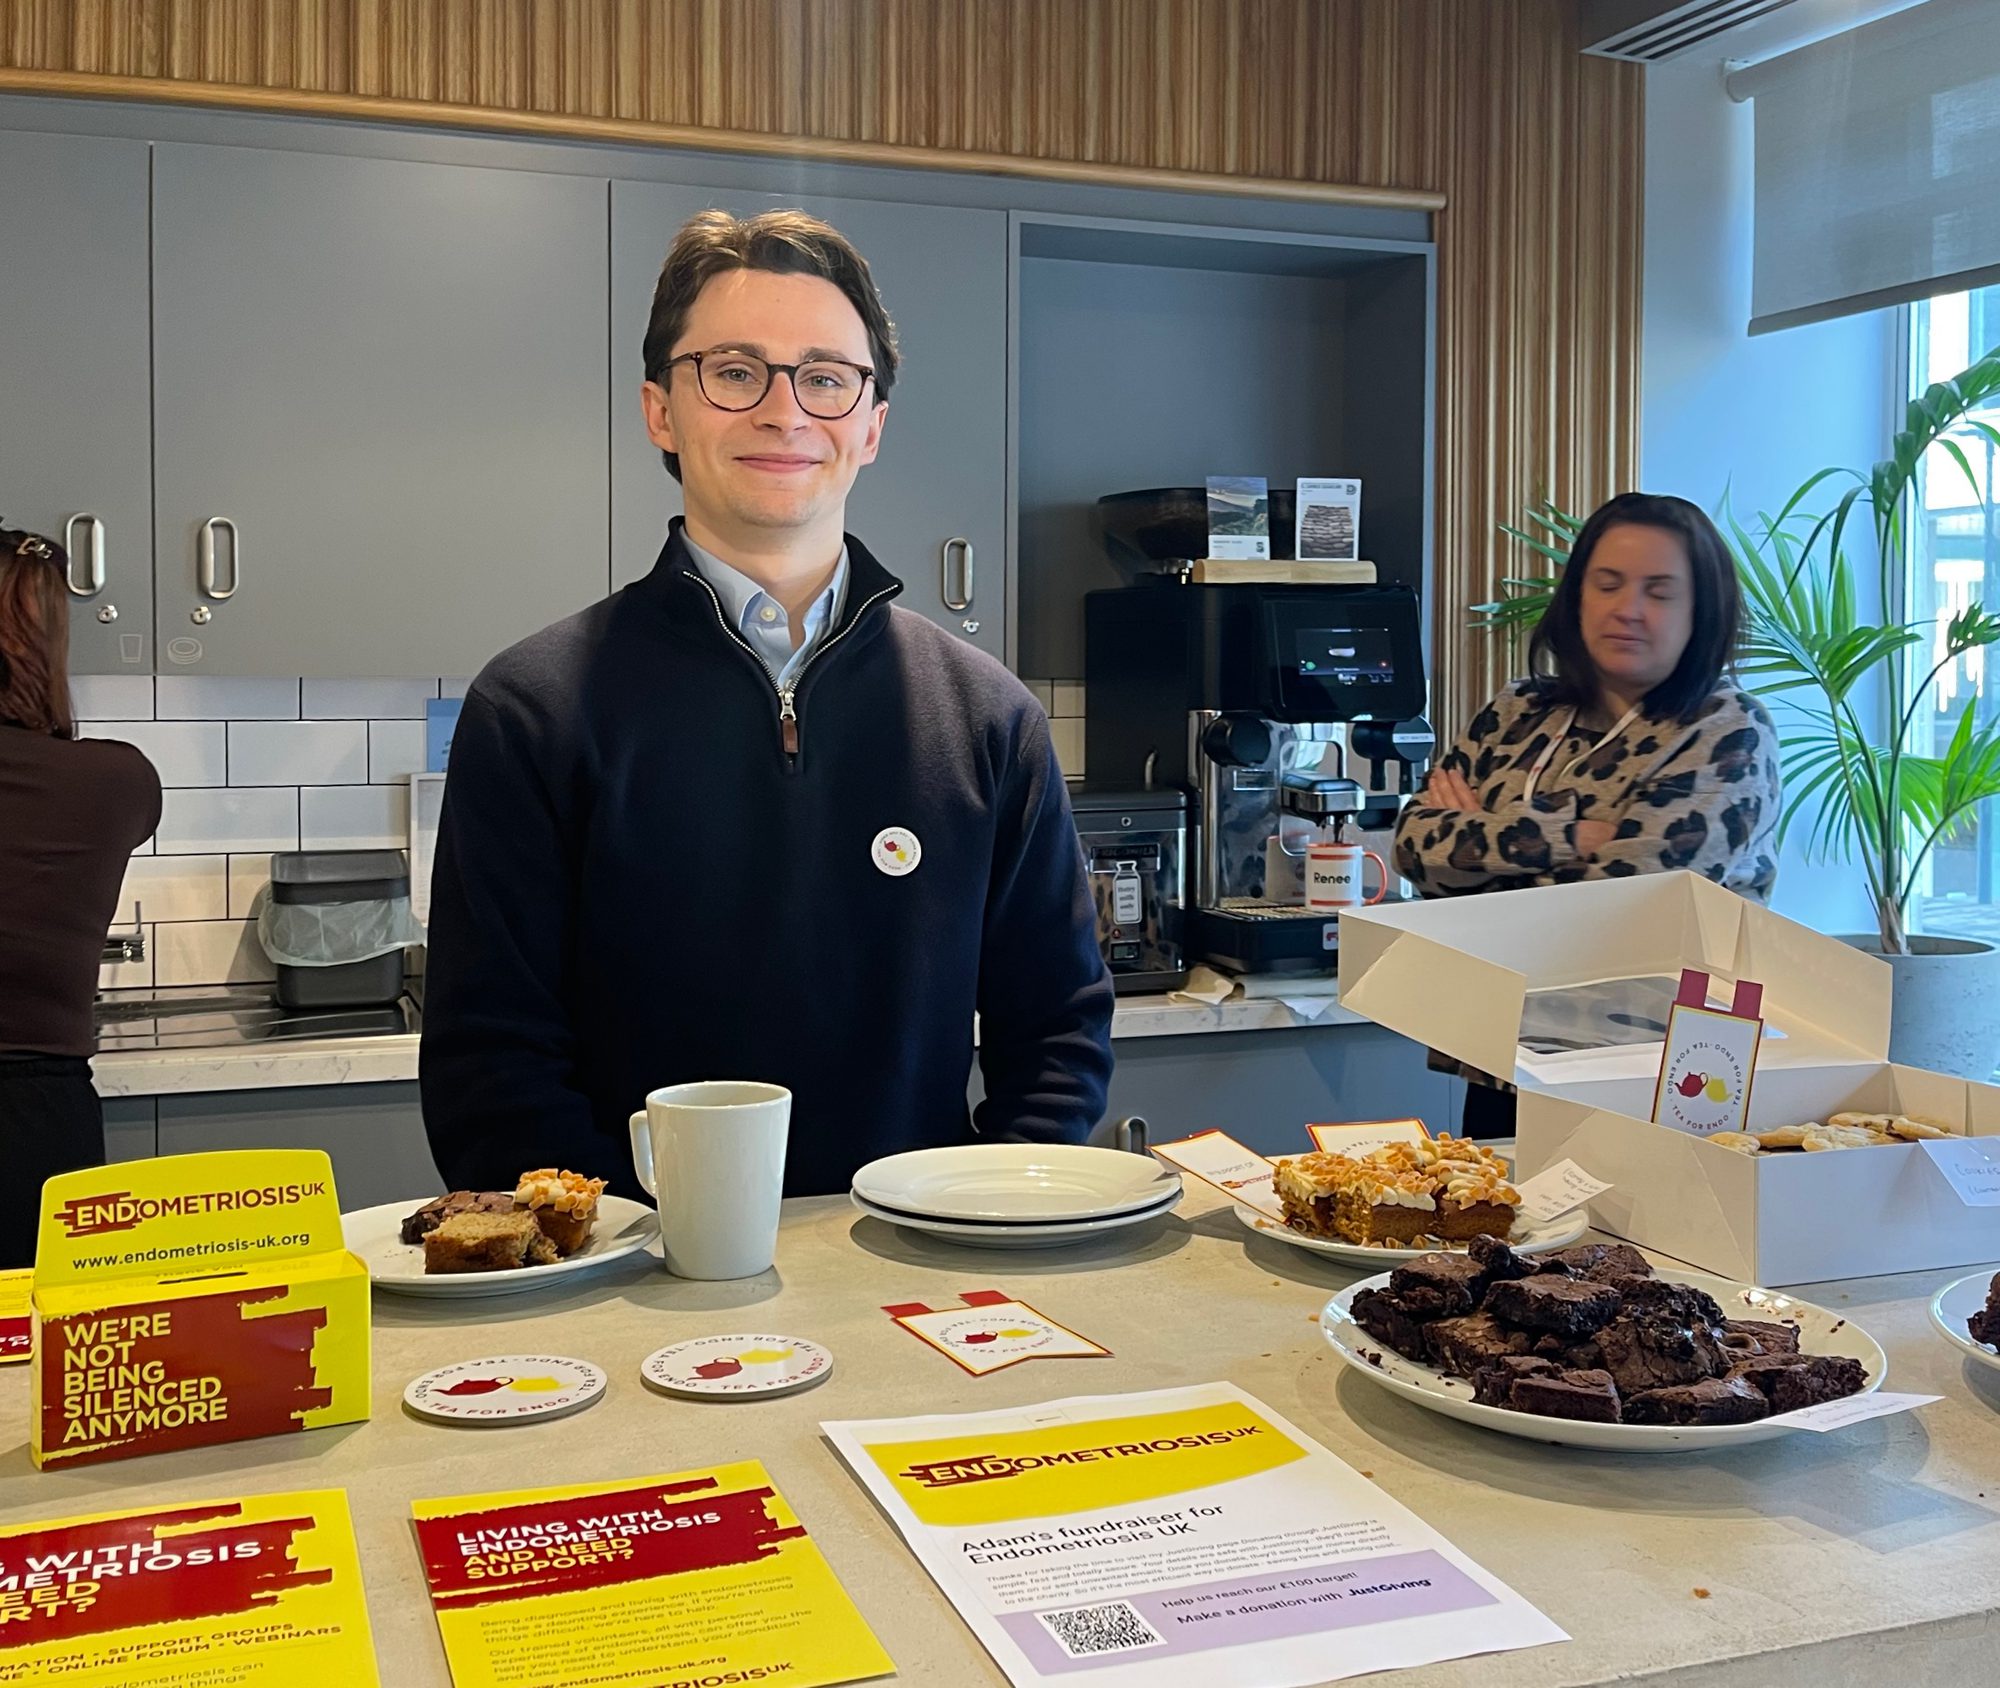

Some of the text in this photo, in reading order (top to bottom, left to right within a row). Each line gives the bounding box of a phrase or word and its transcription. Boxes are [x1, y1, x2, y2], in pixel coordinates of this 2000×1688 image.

[1313, 872, 1351, 884] Renee
[1672, 1105, 1729, 1130] TEA FOR ENDO
[77, 1182, 326, 1227] ENDOMETRIOSIS UK
[73, 1232, 311, 1270] www.endometriosis-uk.org
[63, 1313, 171, 1347] WE'RE
[64, 1341, 135, 1372] NOT
[64, 1362, 165, 1396] BEING
[766, 1375, 800, 1386] FOR
[63, 1377, 222, 1419] SILENCED
[429, 1402, 458, 1414] TEA
[518, 1397, 571, 1413] ENDO
[62, 1397, 228, 1444] ANYMORE
[929, 1424, 1265, 1483] ENDOMETRIOSIS UK
[456, 1509, 663, 1543] LIVING WITH
[460, 1512, 721, 1556] ENDOMETRIOSIS
[962, 1505, 1223, 1552] Adam's fundraiser for
[968, 1522, 1196, 1564] Endometriosis UK
[25, 1540, 163, 1572] WITH
[463, 1538, 631, 1567] AND NEED
[466, 1549, 634, 1579] SUPPORT?
[1160, 1571, 1358, 1608] Help us reach our £100 target!
[1176, 1611, 1221, 1624] Make
[1238, 1598, 1307, 1614] donation
[1308, 1591, 1343, 1603] with
[1348, 1578, 1431, 1596] JustGiving
[48, 1626, 342, 1674] ONLINE FORUM WEBINARS
[108, 1635, 204, 1656] SUPPORT
[210, 1623, 294, 1640] GROUPS
[766, 1662, 795, 1674] UK
